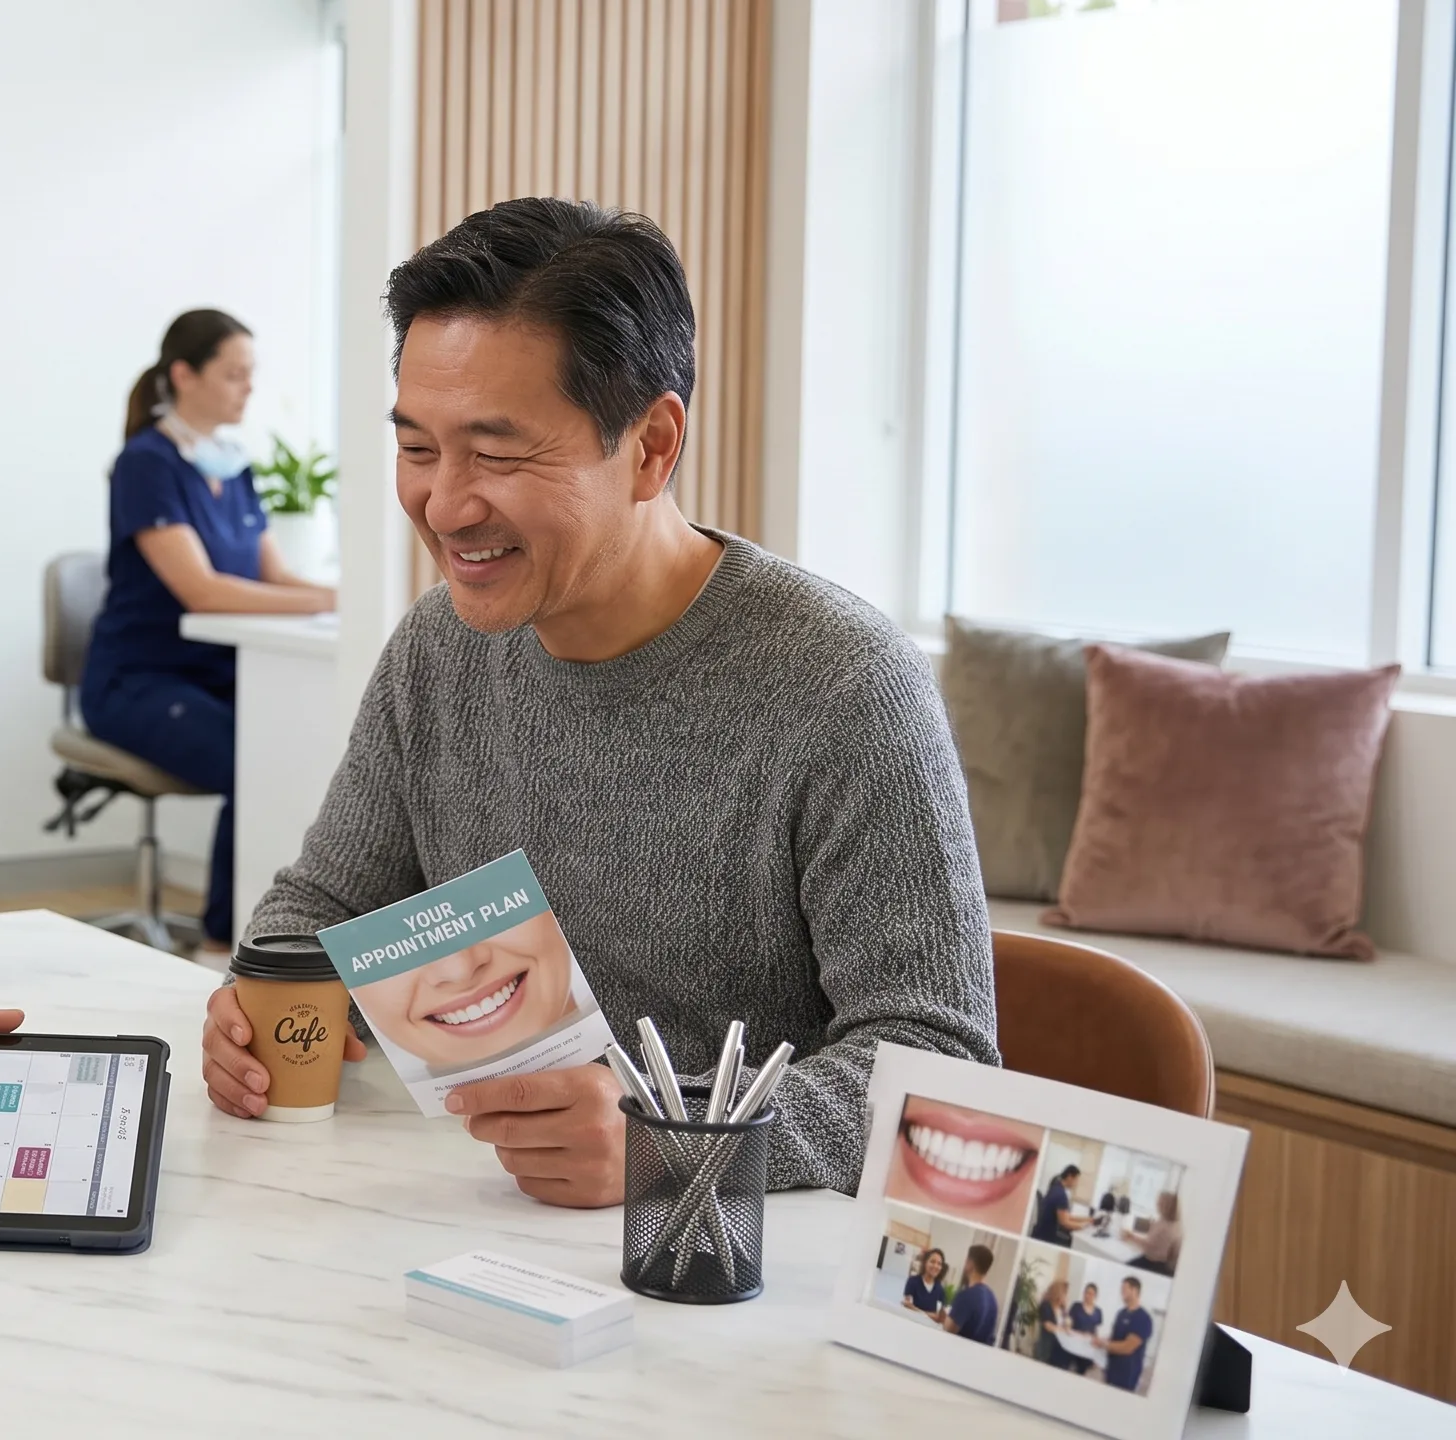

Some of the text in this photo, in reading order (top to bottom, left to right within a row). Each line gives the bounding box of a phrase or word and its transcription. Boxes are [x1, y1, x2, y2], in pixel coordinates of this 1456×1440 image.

[351, 888, 530, 972] APPOINTMENT PLAN
[403, 902, 456, 932] YOUR
[274, 1016, 329, 1052] Cafe
